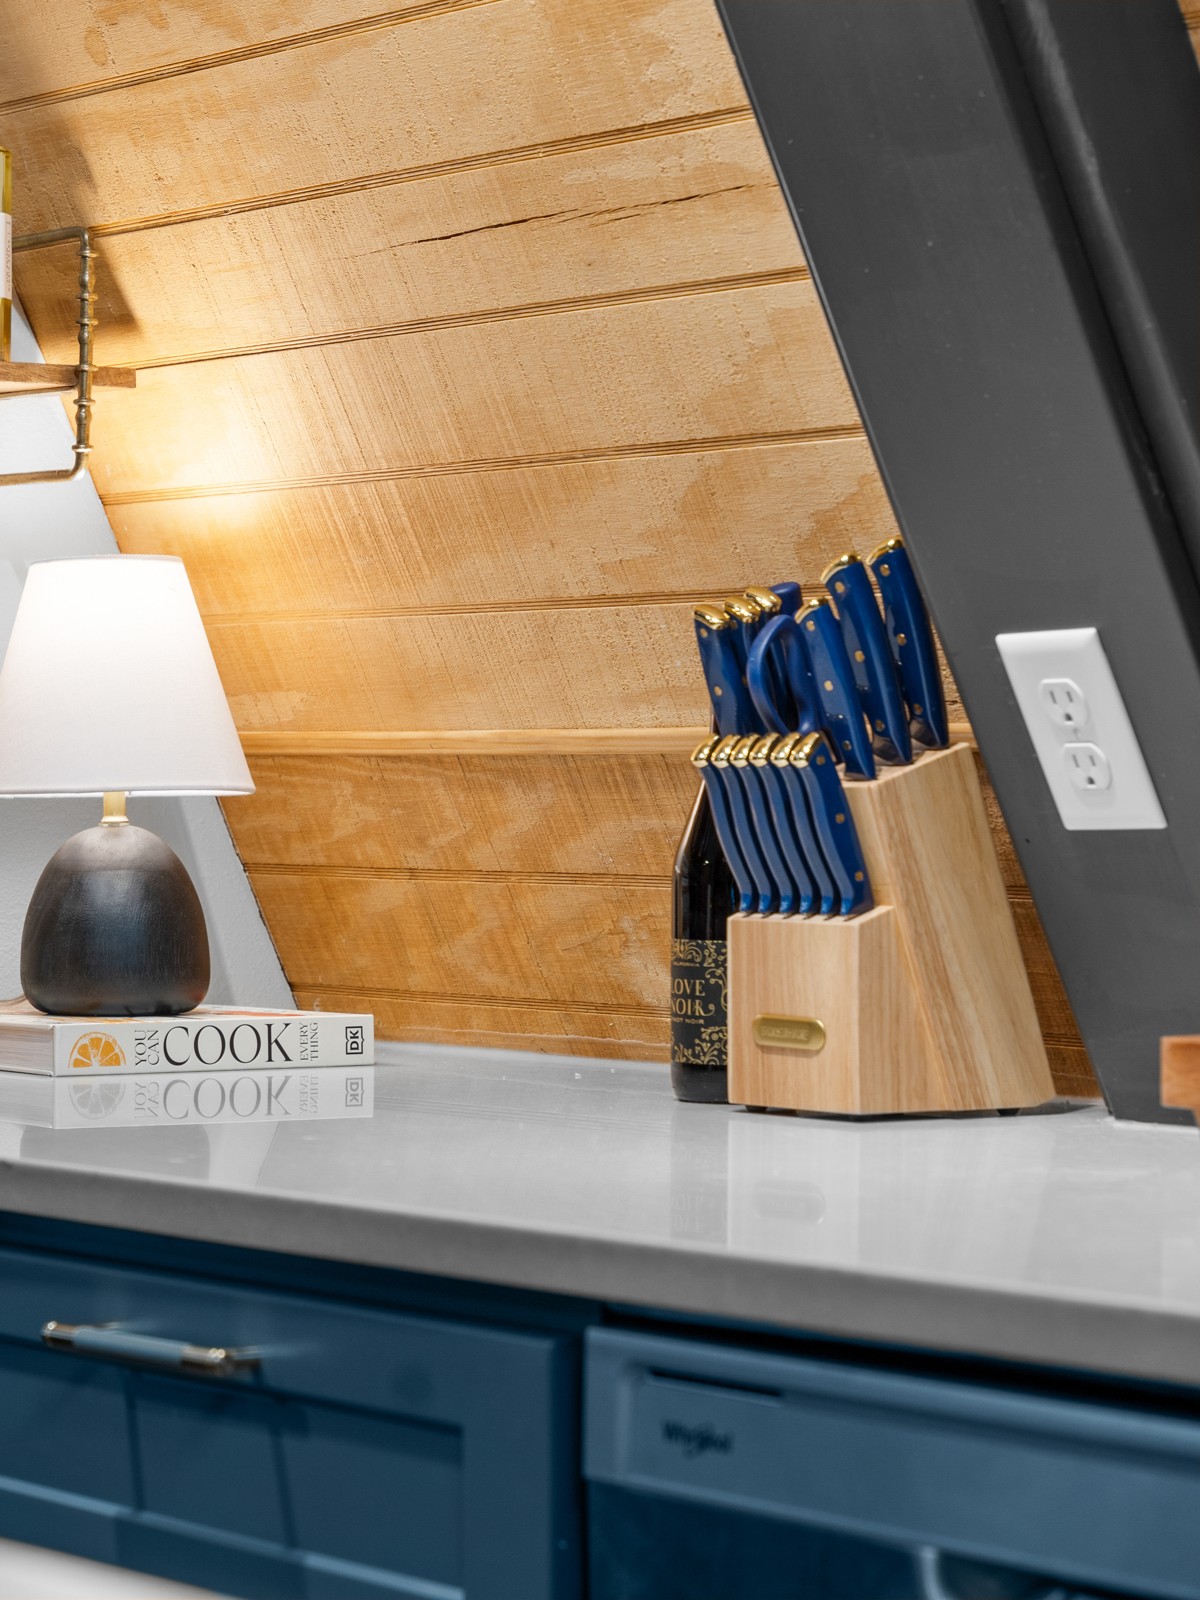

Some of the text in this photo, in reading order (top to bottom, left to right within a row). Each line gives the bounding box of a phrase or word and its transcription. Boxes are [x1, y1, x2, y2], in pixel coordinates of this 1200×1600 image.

[134, 1029, 147, 1066] YOU
[147, 1029, 160, 1066] CAN
[163, 1023, 293, 1066] COOK
[300, 1022, 308, 1061] EVERY
[310, 1022, 319, 1061] THING
[350, 1029, 360, 1051] DK
